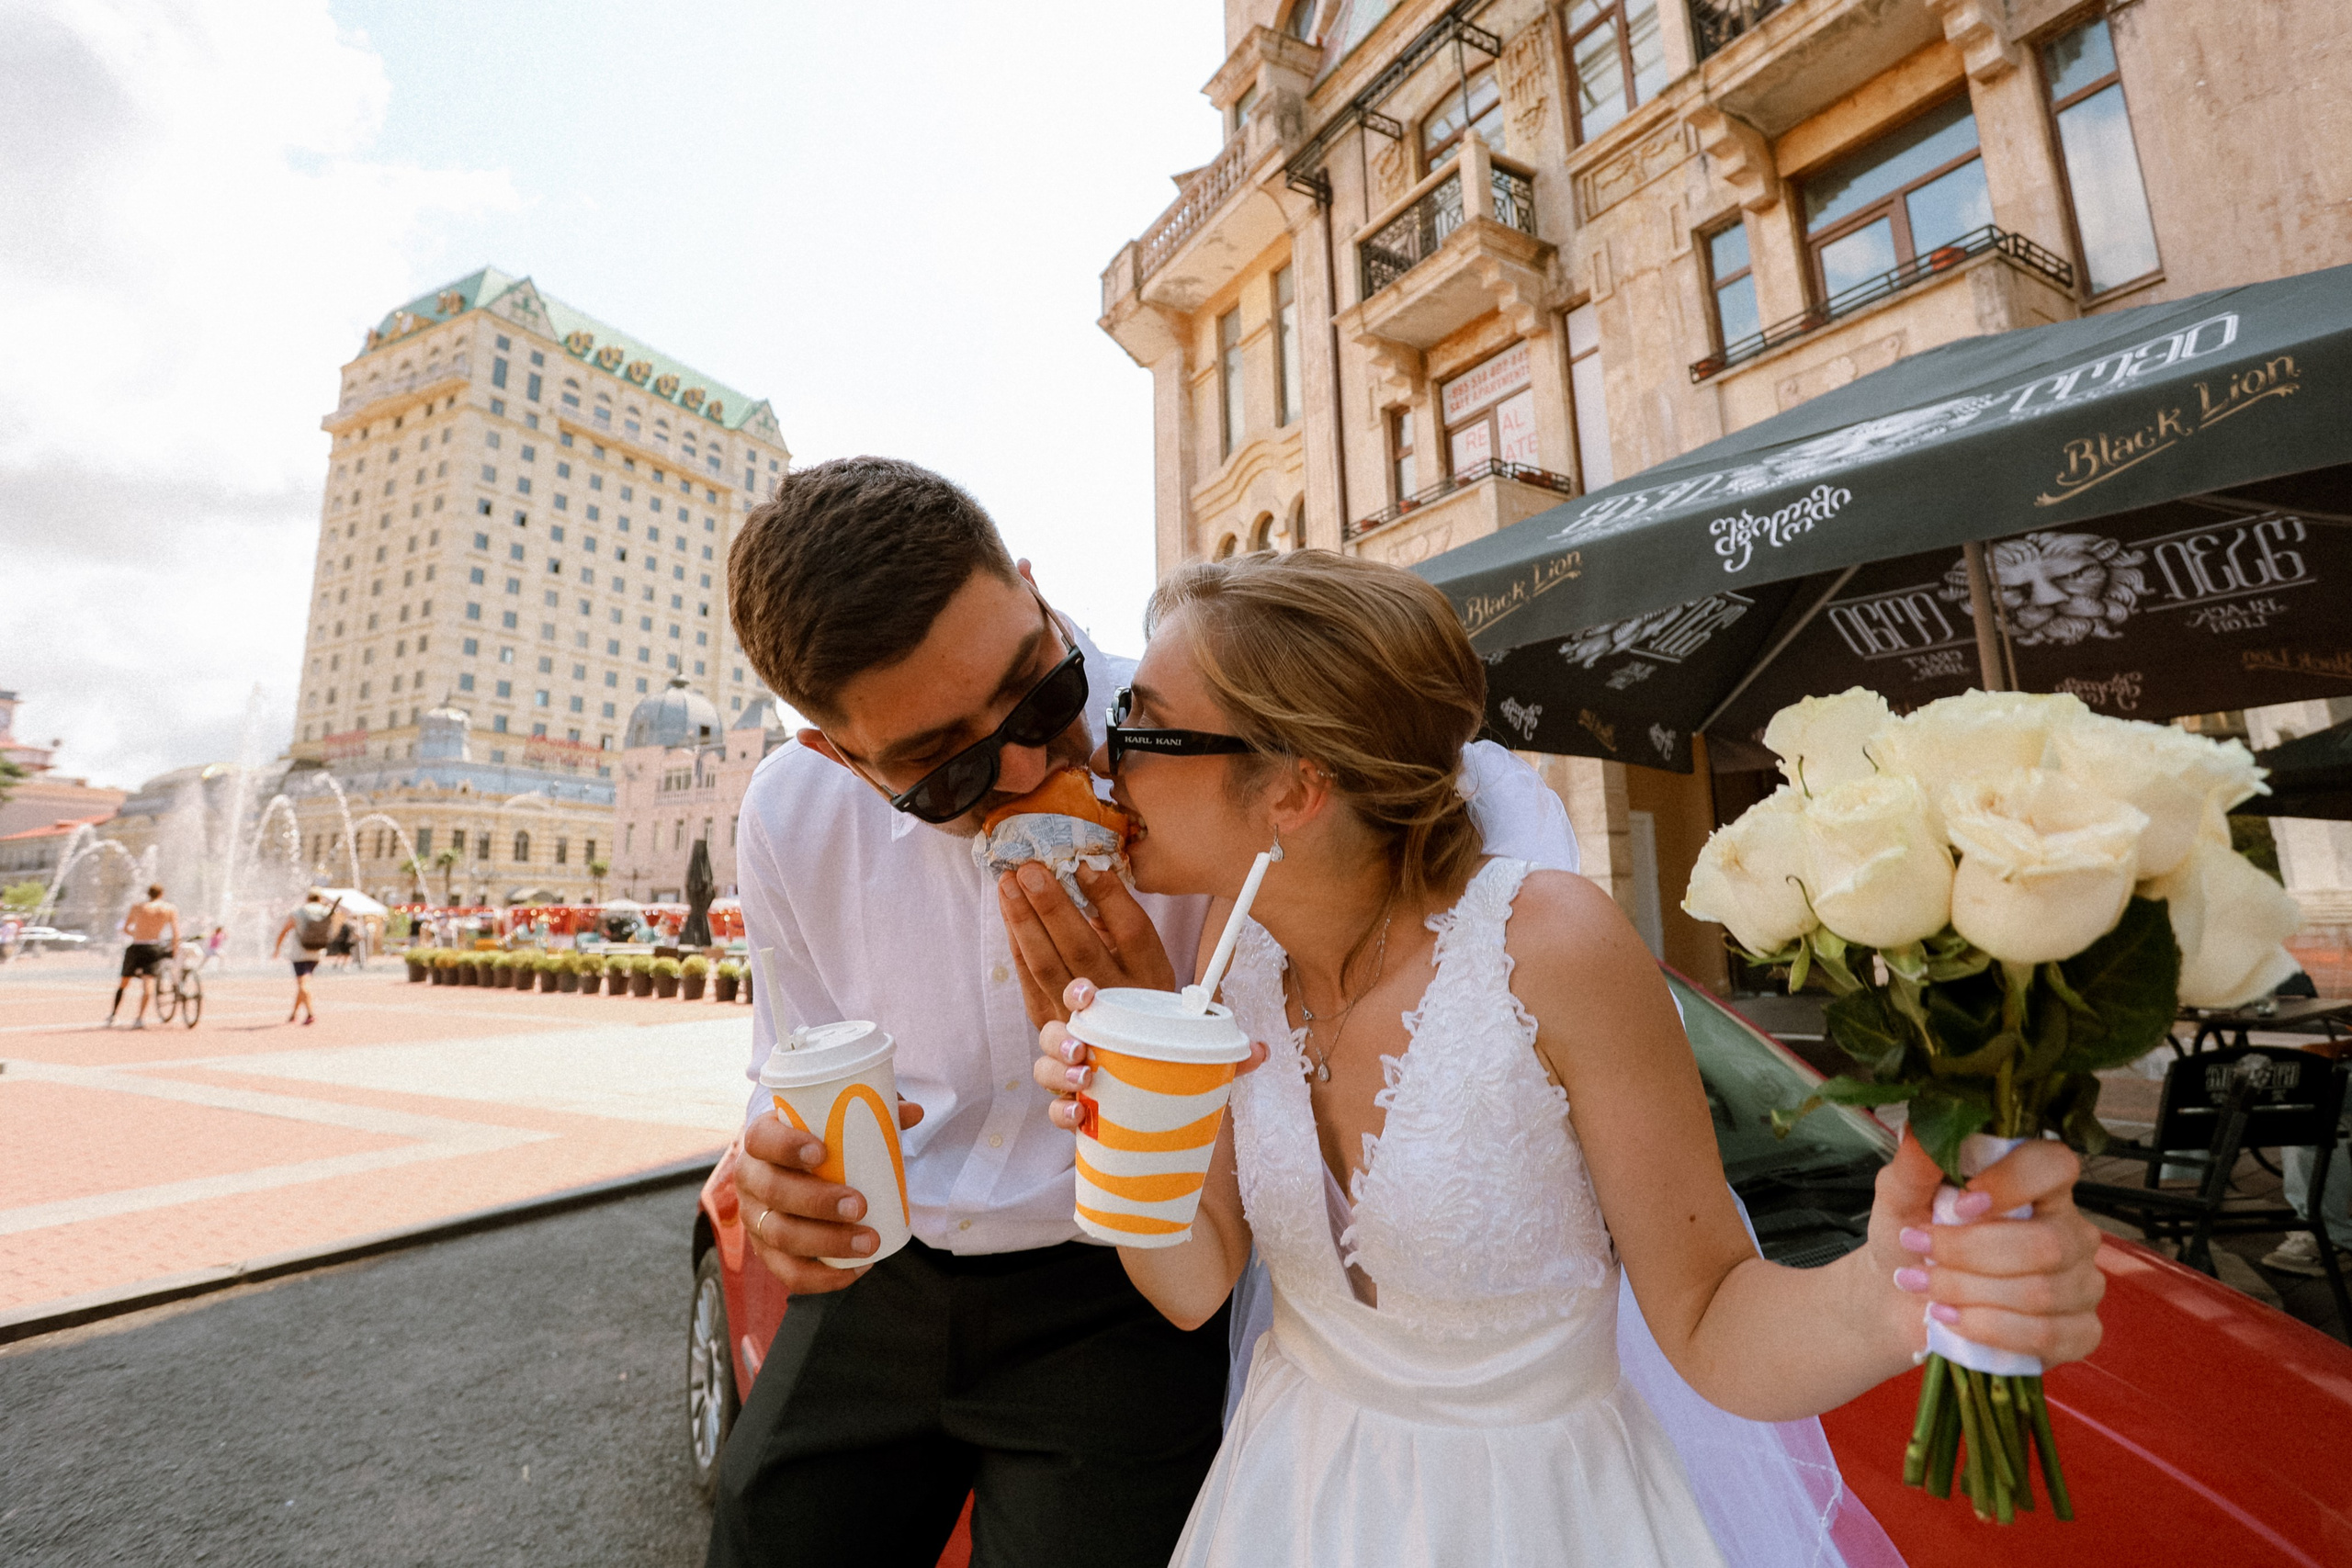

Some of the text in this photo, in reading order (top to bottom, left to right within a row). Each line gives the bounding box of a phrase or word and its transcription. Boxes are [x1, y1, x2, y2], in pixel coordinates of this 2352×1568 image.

[2055, 407, 2193, 487] Black
[2194, 355, 2301, 422] Lion
[1463, 550, 1583, 632] Black Lion
[1124, 735, 1182, 747] KARL KANI
